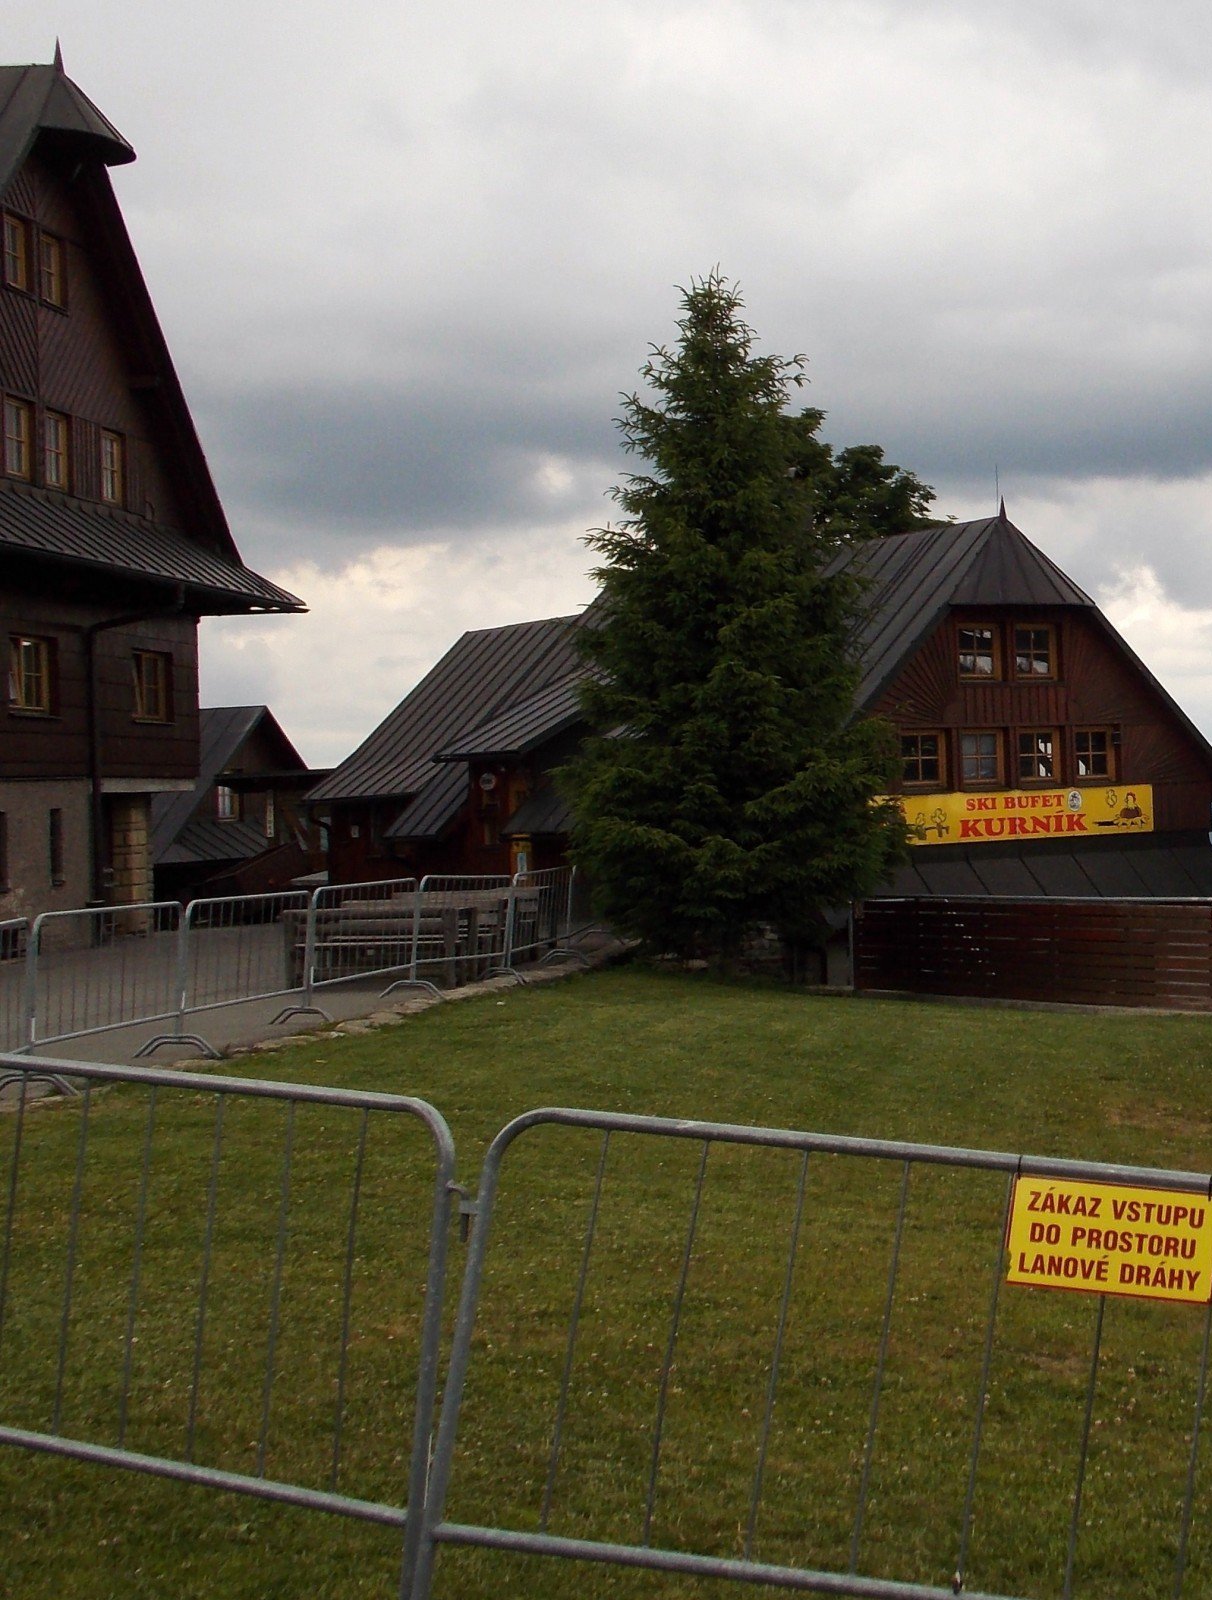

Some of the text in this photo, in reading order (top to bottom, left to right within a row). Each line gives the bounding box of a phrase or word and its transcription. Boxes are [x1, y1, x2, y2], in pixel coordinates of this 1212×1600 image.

[966, 794, 1065, 812] SKI BUFET
[959, 811, 1088, 838] KURNÍK
[1027, 1187, 1205, 1229] ZÁKAZ VSTUPU
[1029, 1222, 1197, 1259] DO PROSTORU
[1018, 1252, 1201, 1291] LANOVÉ DRÁHY
